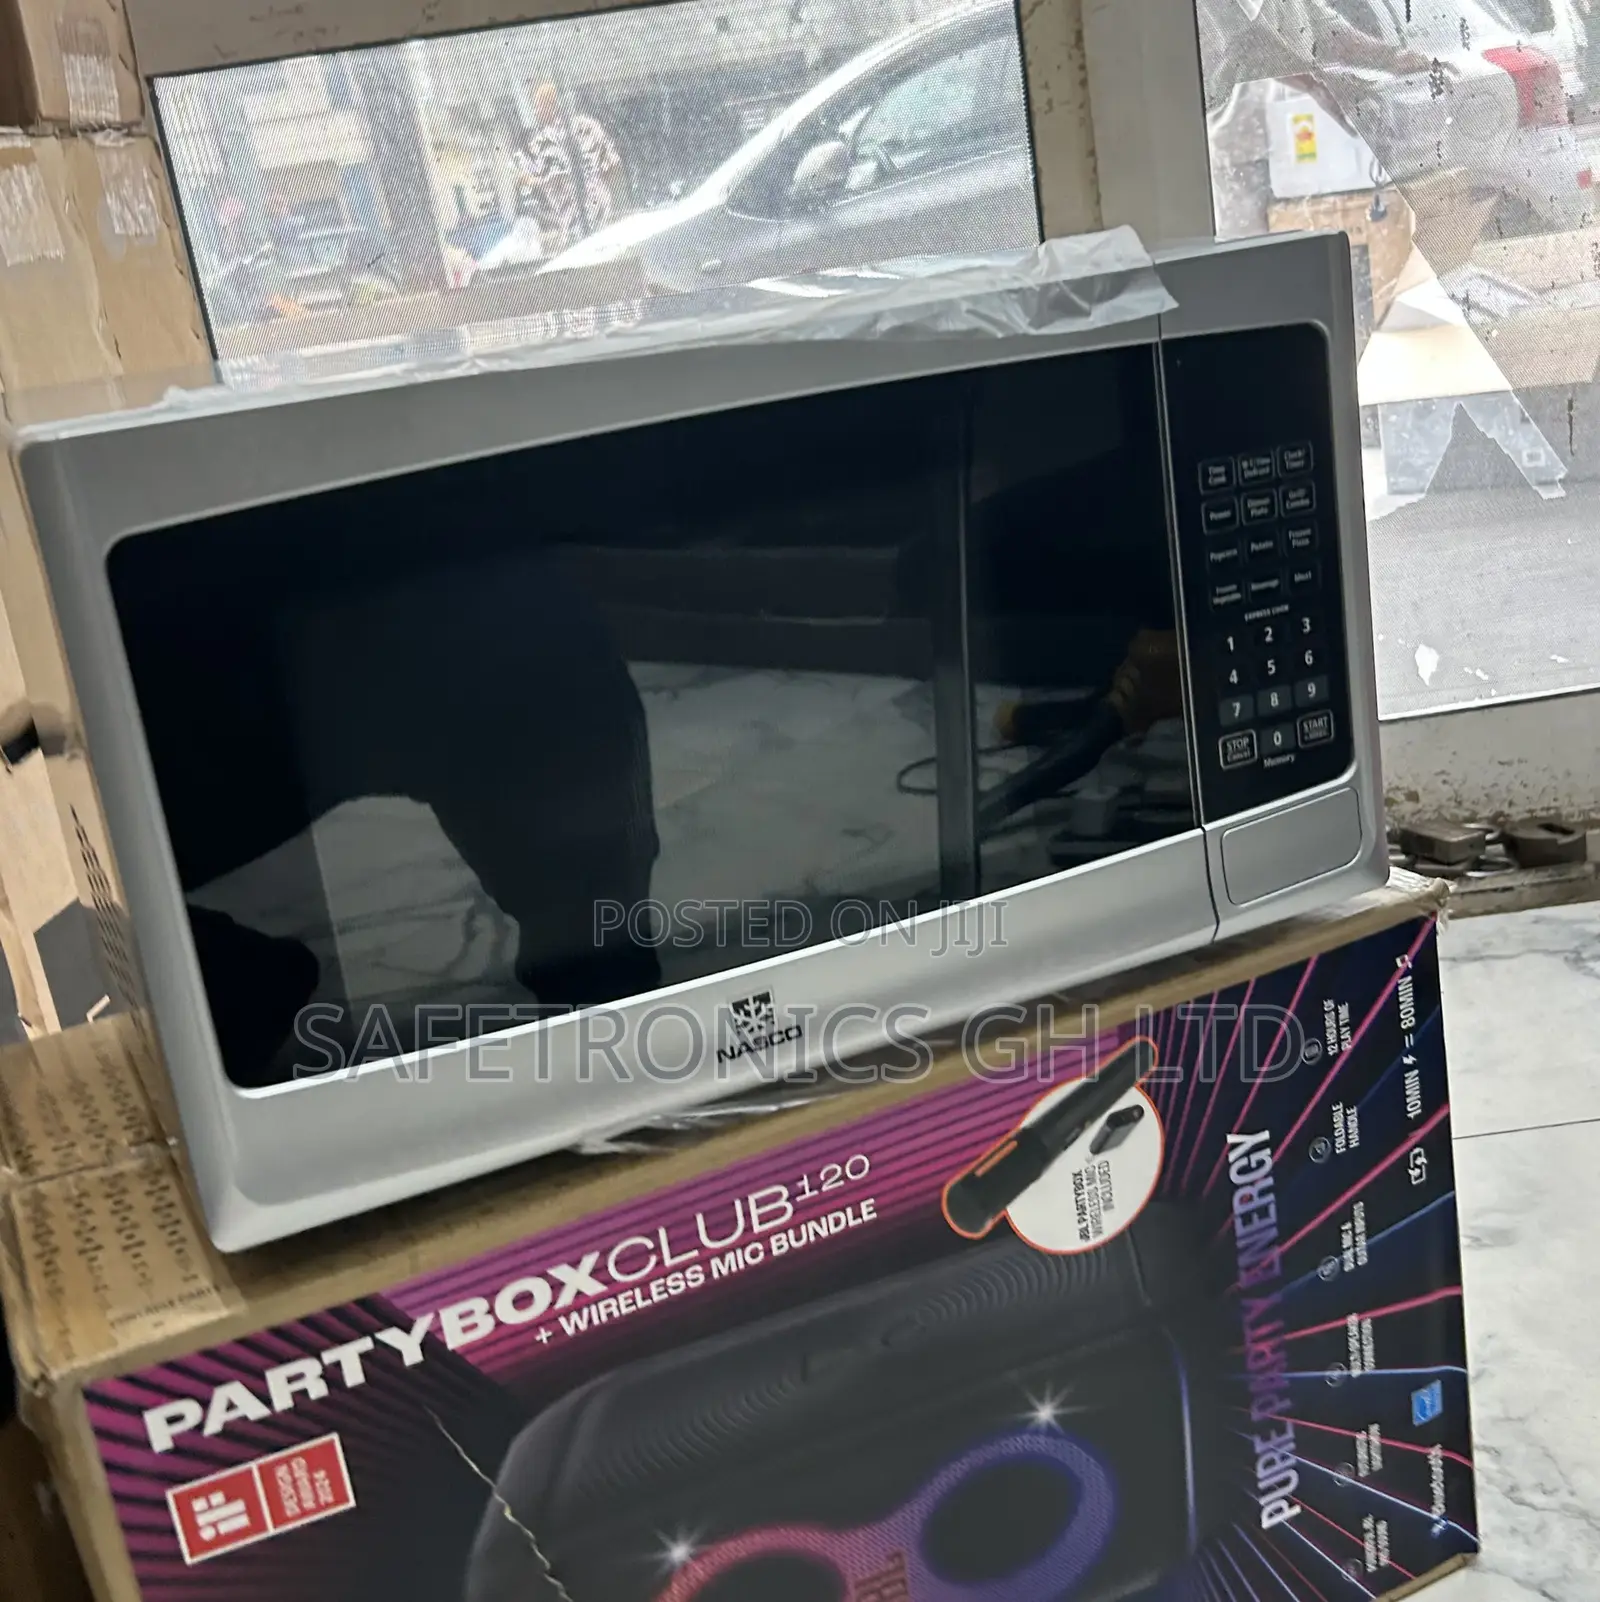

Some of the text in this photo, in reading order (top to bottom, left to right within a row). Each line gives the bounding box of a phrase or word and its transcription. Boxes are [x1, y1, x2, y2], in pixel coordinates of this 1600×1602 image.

[1227, 617, 1311, 652] 1 2 3
[1229, 650, 1314, 685] 4 5 6
[1232, 682, 1316, 719] 7 8 9
[1226, 716, 1328, 751] STOP 0 START
[1263, 754, 1295, 769] Memory
[1397, 976, 1416, 1029] 80MIN
[716, 1024, 803, 1064] NASCO
[1327, 1044, 1338, 1056] 12
[1404, 1069, 1422, 1119] 10MIN
[1331, 1101, 1346, 1154] FOLDABLE
[1345, 1105, 1360, 1148] HANDLE
[795, 1154, 871, 1203] 120
[1226, 1129, 1283, 1288] ENERGY
[558, 1264, 706, 1338] WIRELESS
[710, 1242, 765, 1280] MIC
[769, 1198, 878, 1257] BUNDLE
[1256, 1418, 1302, 1530] PURE
